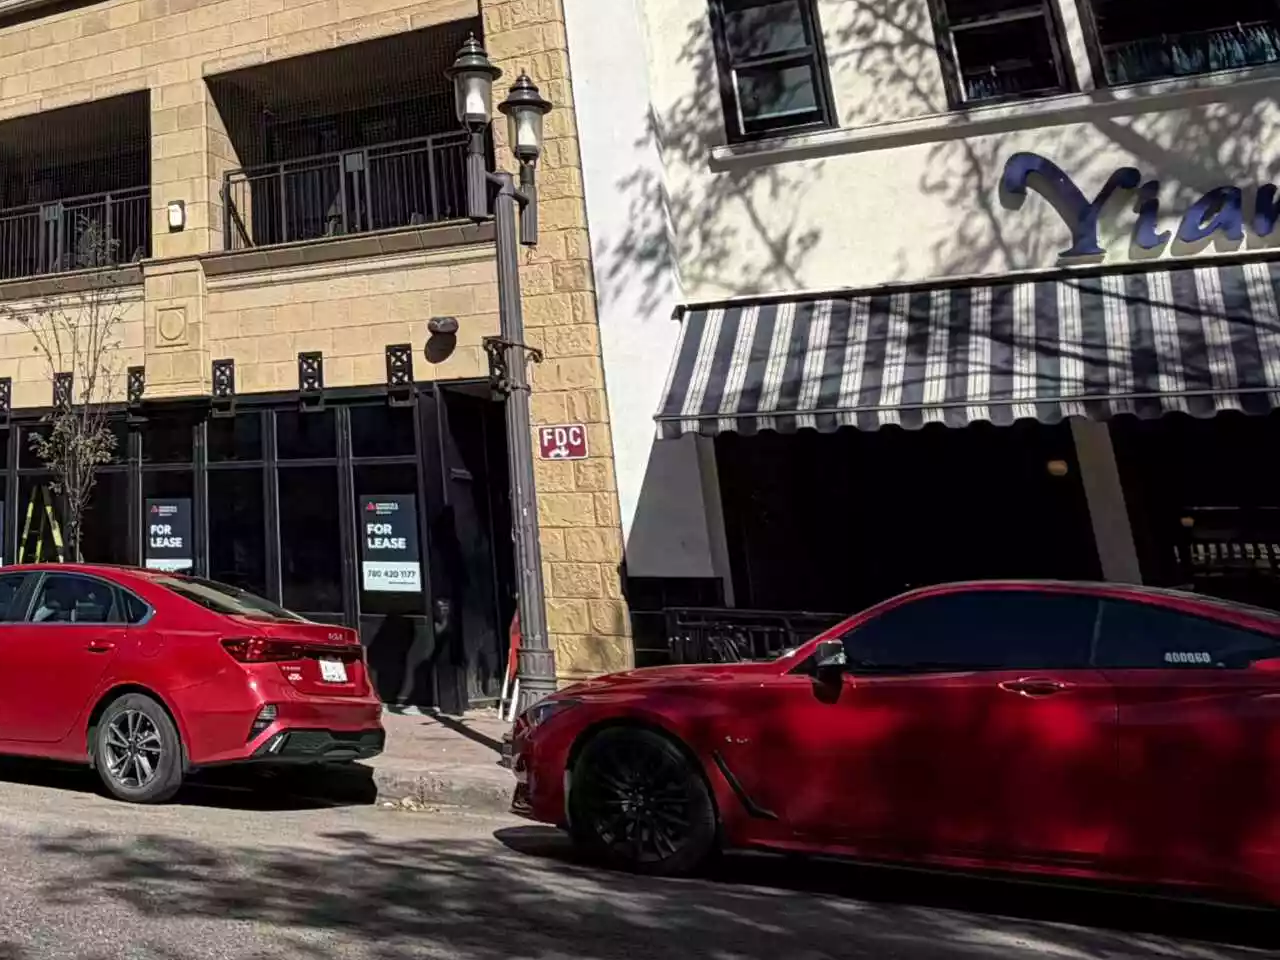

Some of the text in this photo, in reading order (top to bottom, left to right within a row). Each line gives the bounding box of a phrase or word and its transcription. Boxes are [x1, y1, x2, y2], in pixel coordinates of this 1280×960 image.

[542, 427, 582, 447] FDC
[150, 524, 172, 535] FOR
[367, 524, 392, 535] FOR
[150, 537, 183, 548] LEASE
[367, 538, 407, 549] LEASE
